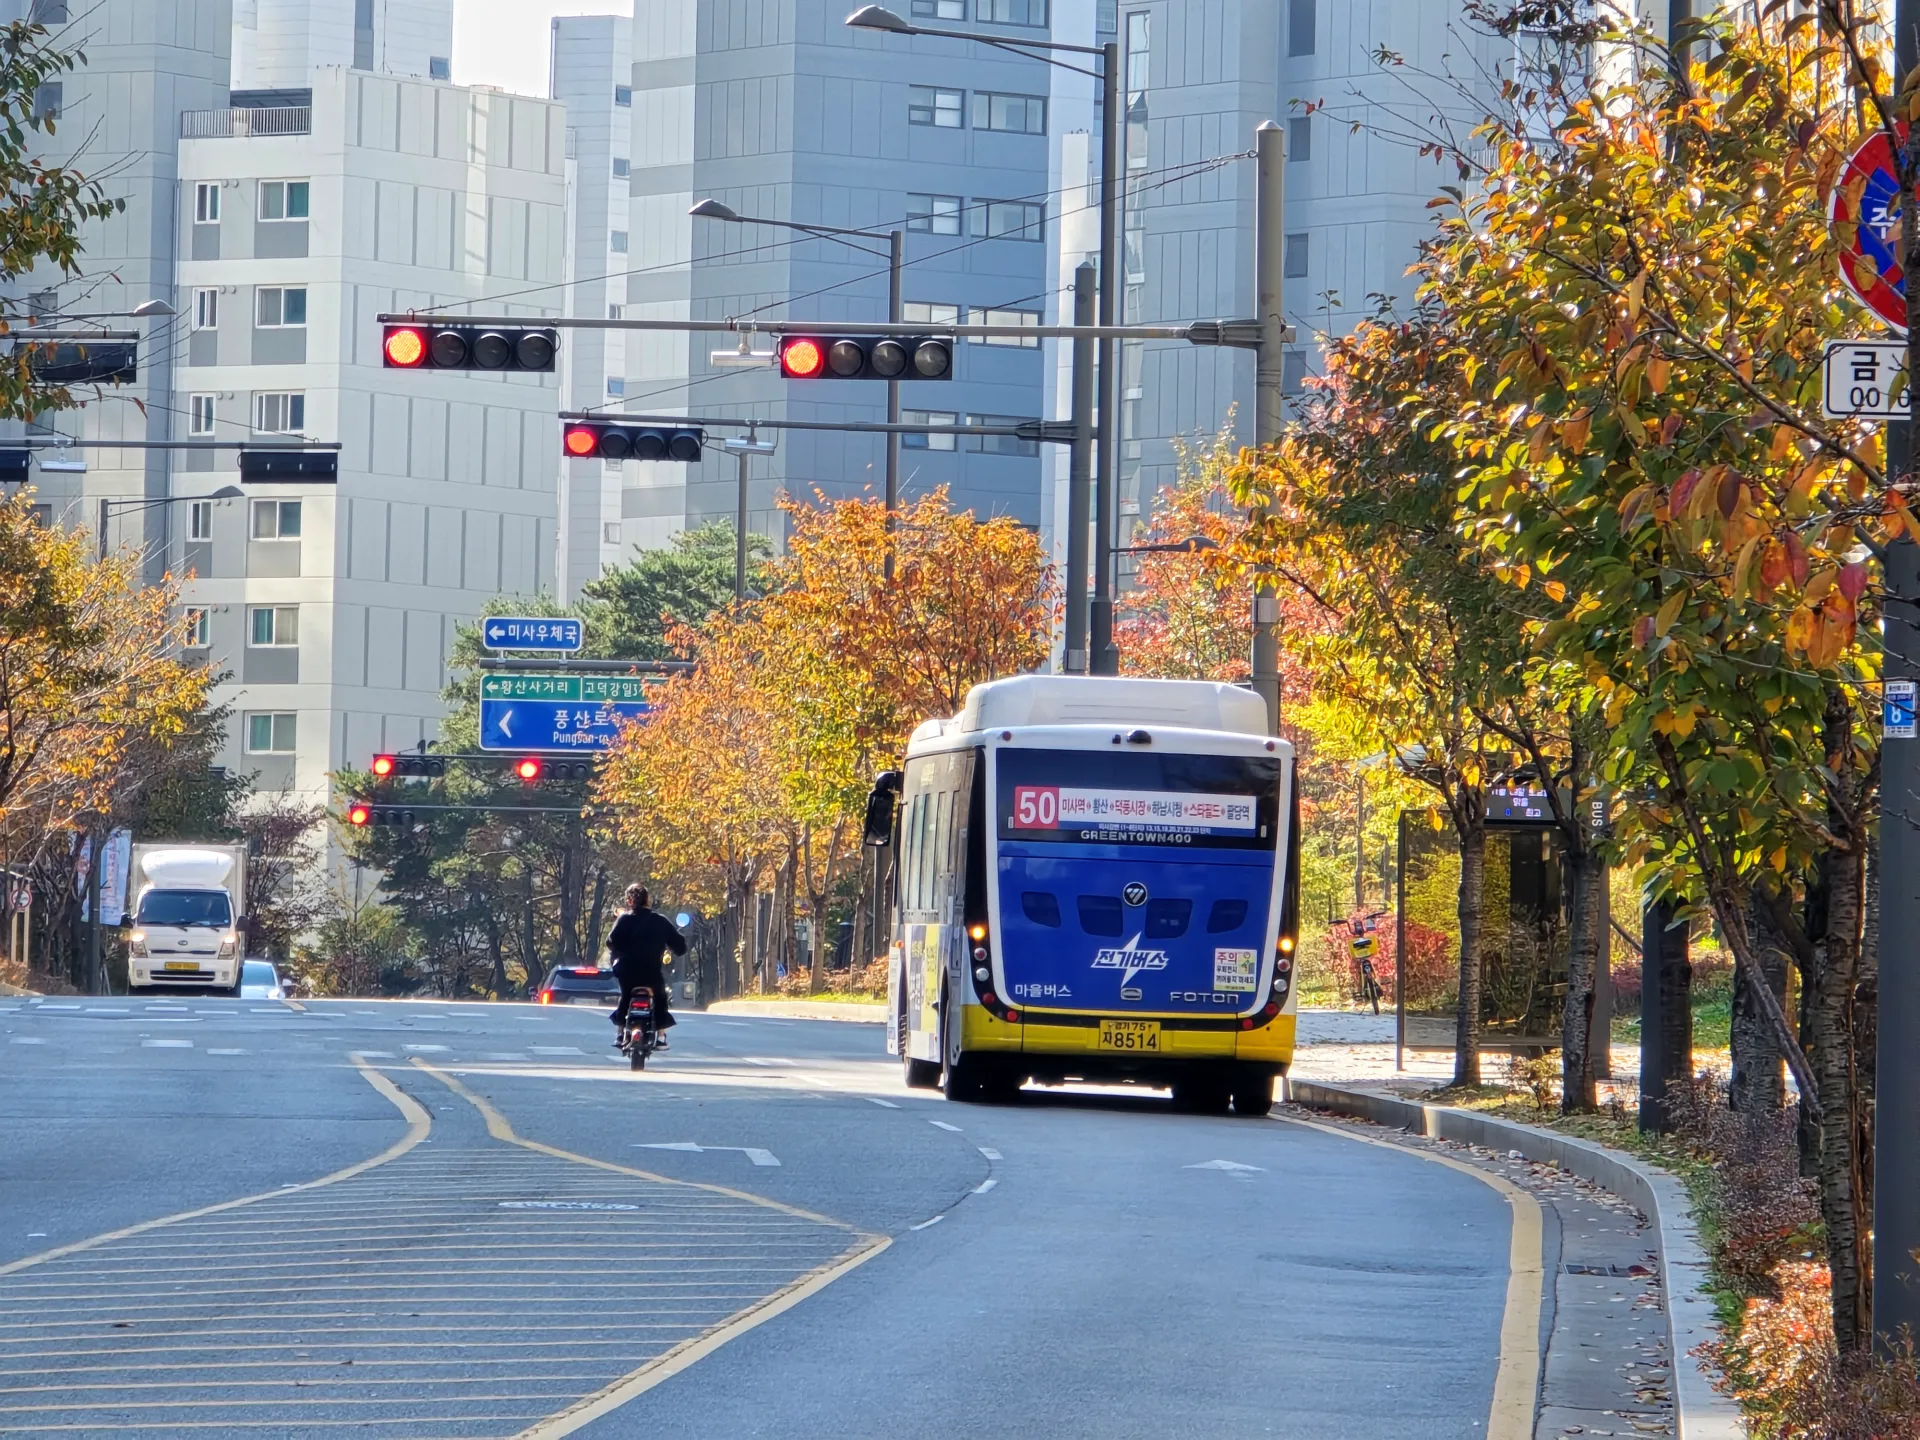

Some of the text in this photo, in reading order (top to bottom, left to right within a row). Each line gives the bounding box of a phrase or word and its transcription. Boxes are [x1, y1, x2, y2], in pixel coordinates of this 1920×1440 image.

[508, 624, 577, 645] 미사우체국
[501, 680, 568, 695] 황산사거리
[584, 682, 660, 698] 고덕강일3
[553, 709, 609, 729] 풍산로
[1019, 791, 1056, 825] 50
[1062, 797, 1086, 815] 미사역
[1092, 798, 1109, 815] 황산
[1115, 799, 1146, 816] 덕풍시장
[1151, 800, 1183, 818] 하남시청
[1226, 804, 1250, 822] 팔당역
[1592, 801, 1603, 827] BUS
[1080, 830, 1192, 844] GREENTOWN400
[1093, 950, 1167, 969] 전기버스
[1216, 952, 1238, 964] 주의
[1015, 983, 1072, 998] 마을버스
[1132, 1022, 1146, 1031] 75
